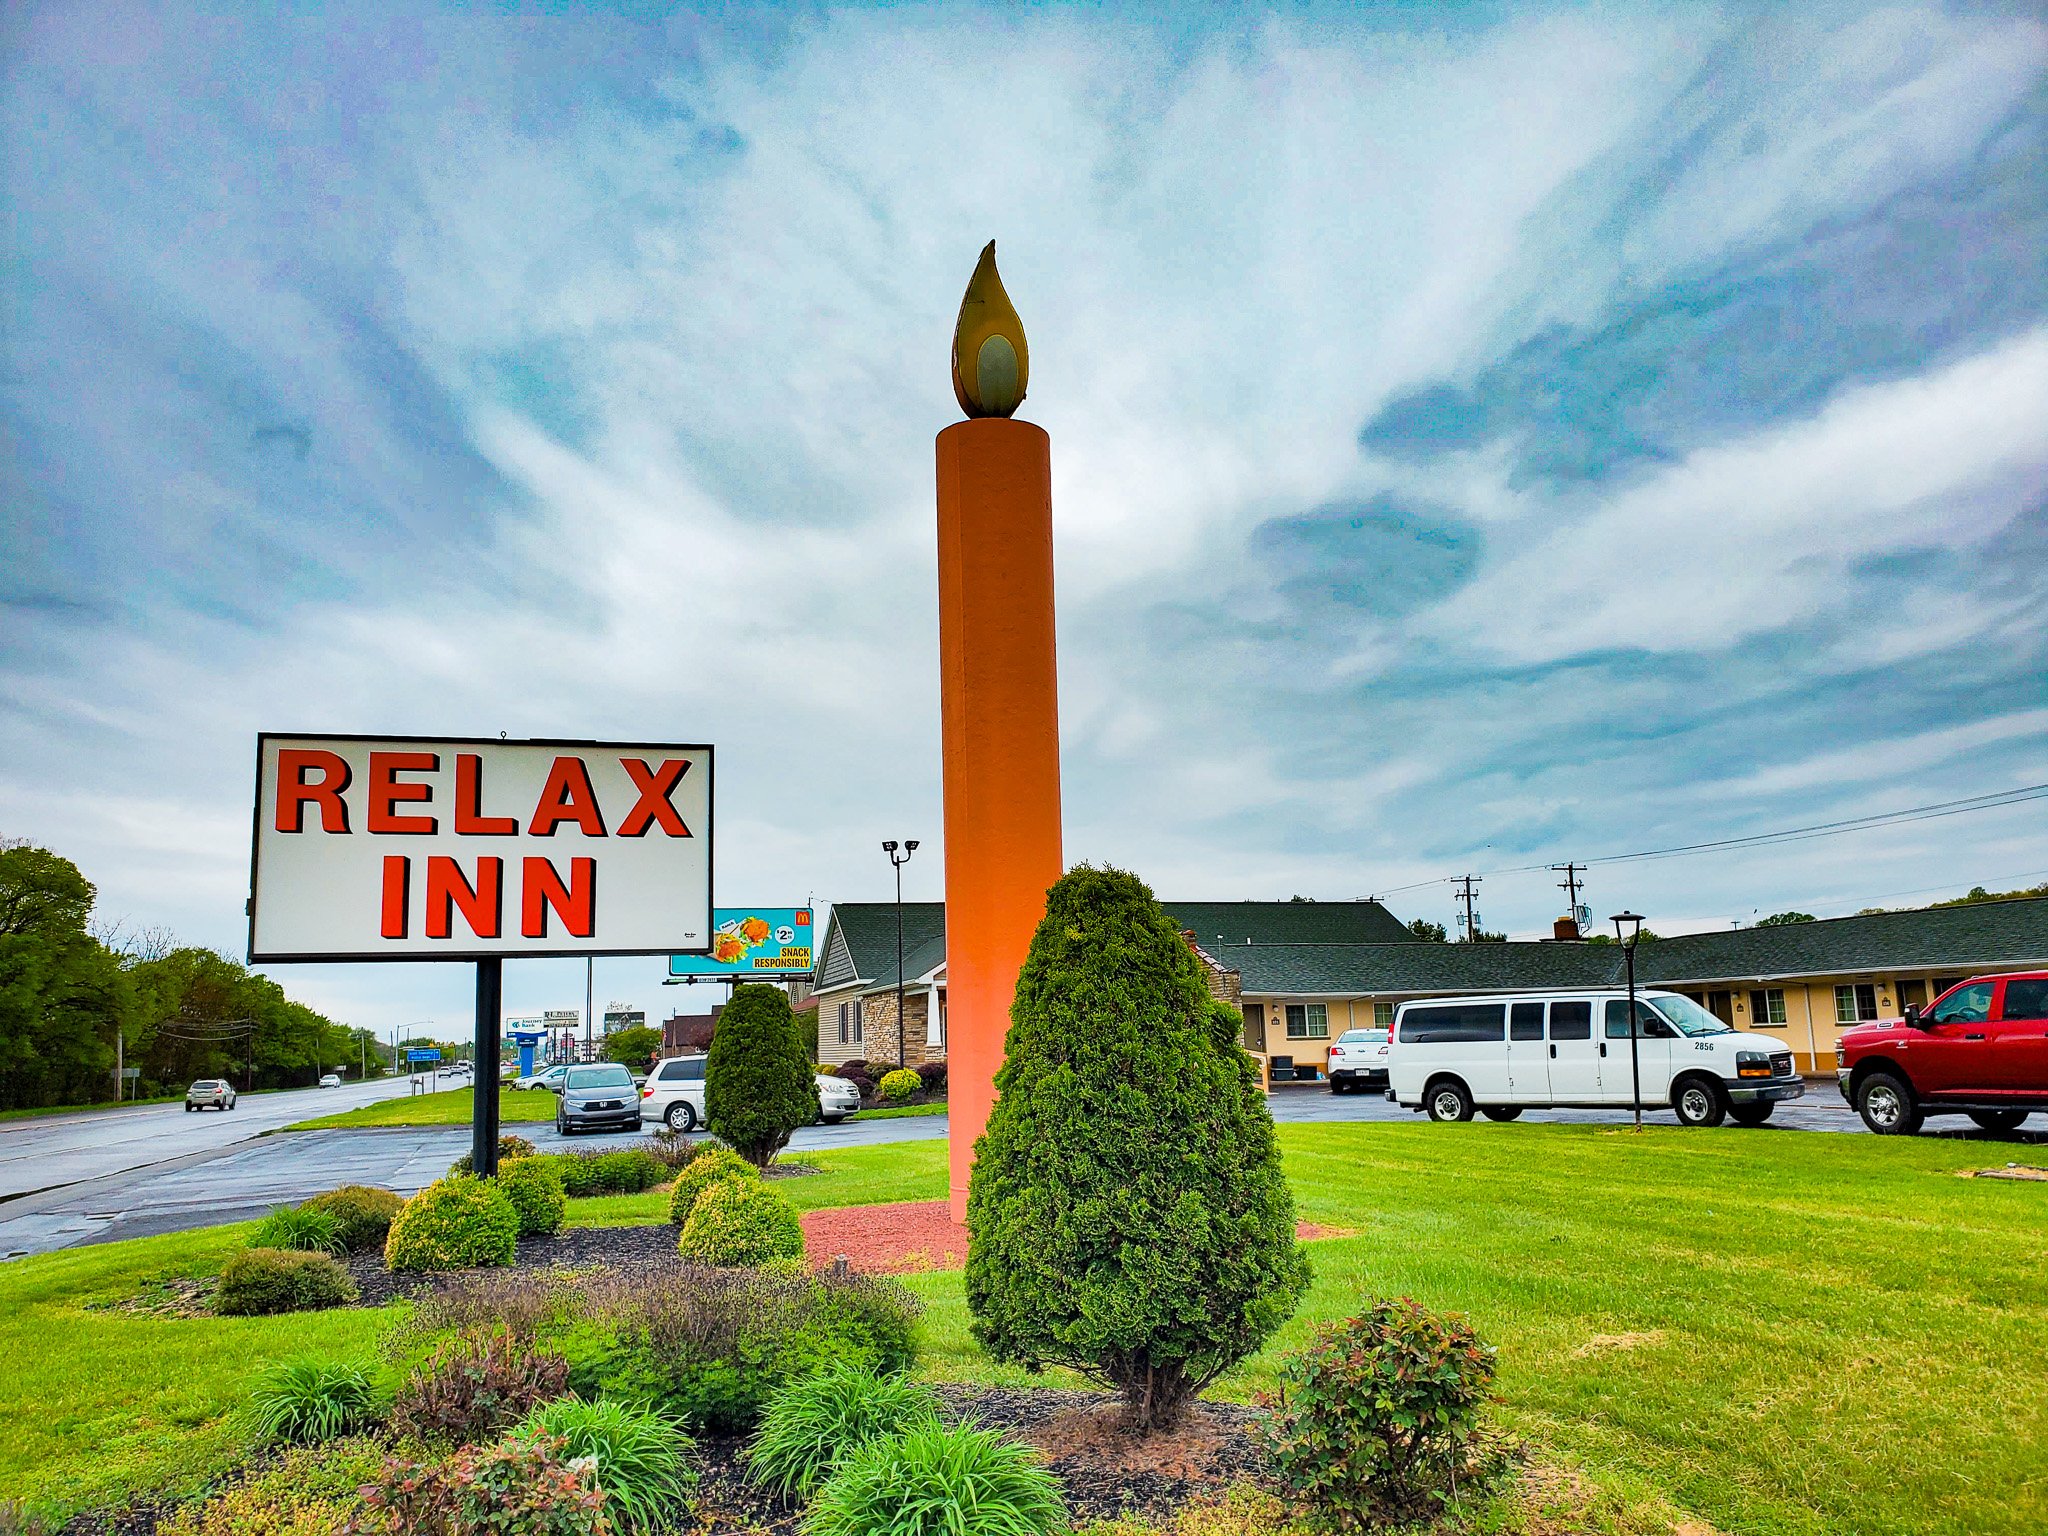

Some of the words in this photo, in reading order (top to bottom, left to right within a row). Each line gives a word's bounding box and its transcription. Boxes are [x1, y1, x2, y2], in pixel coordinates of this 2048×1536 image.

[275, 748, 694, 838] RELAX
[380, 855, 597, 939] INN
[781, 947, 809, 957] SNACK
[754, 958, 809, 968] RESPONSIBLY
[1695, 1041, 1714, 1051] 2856
